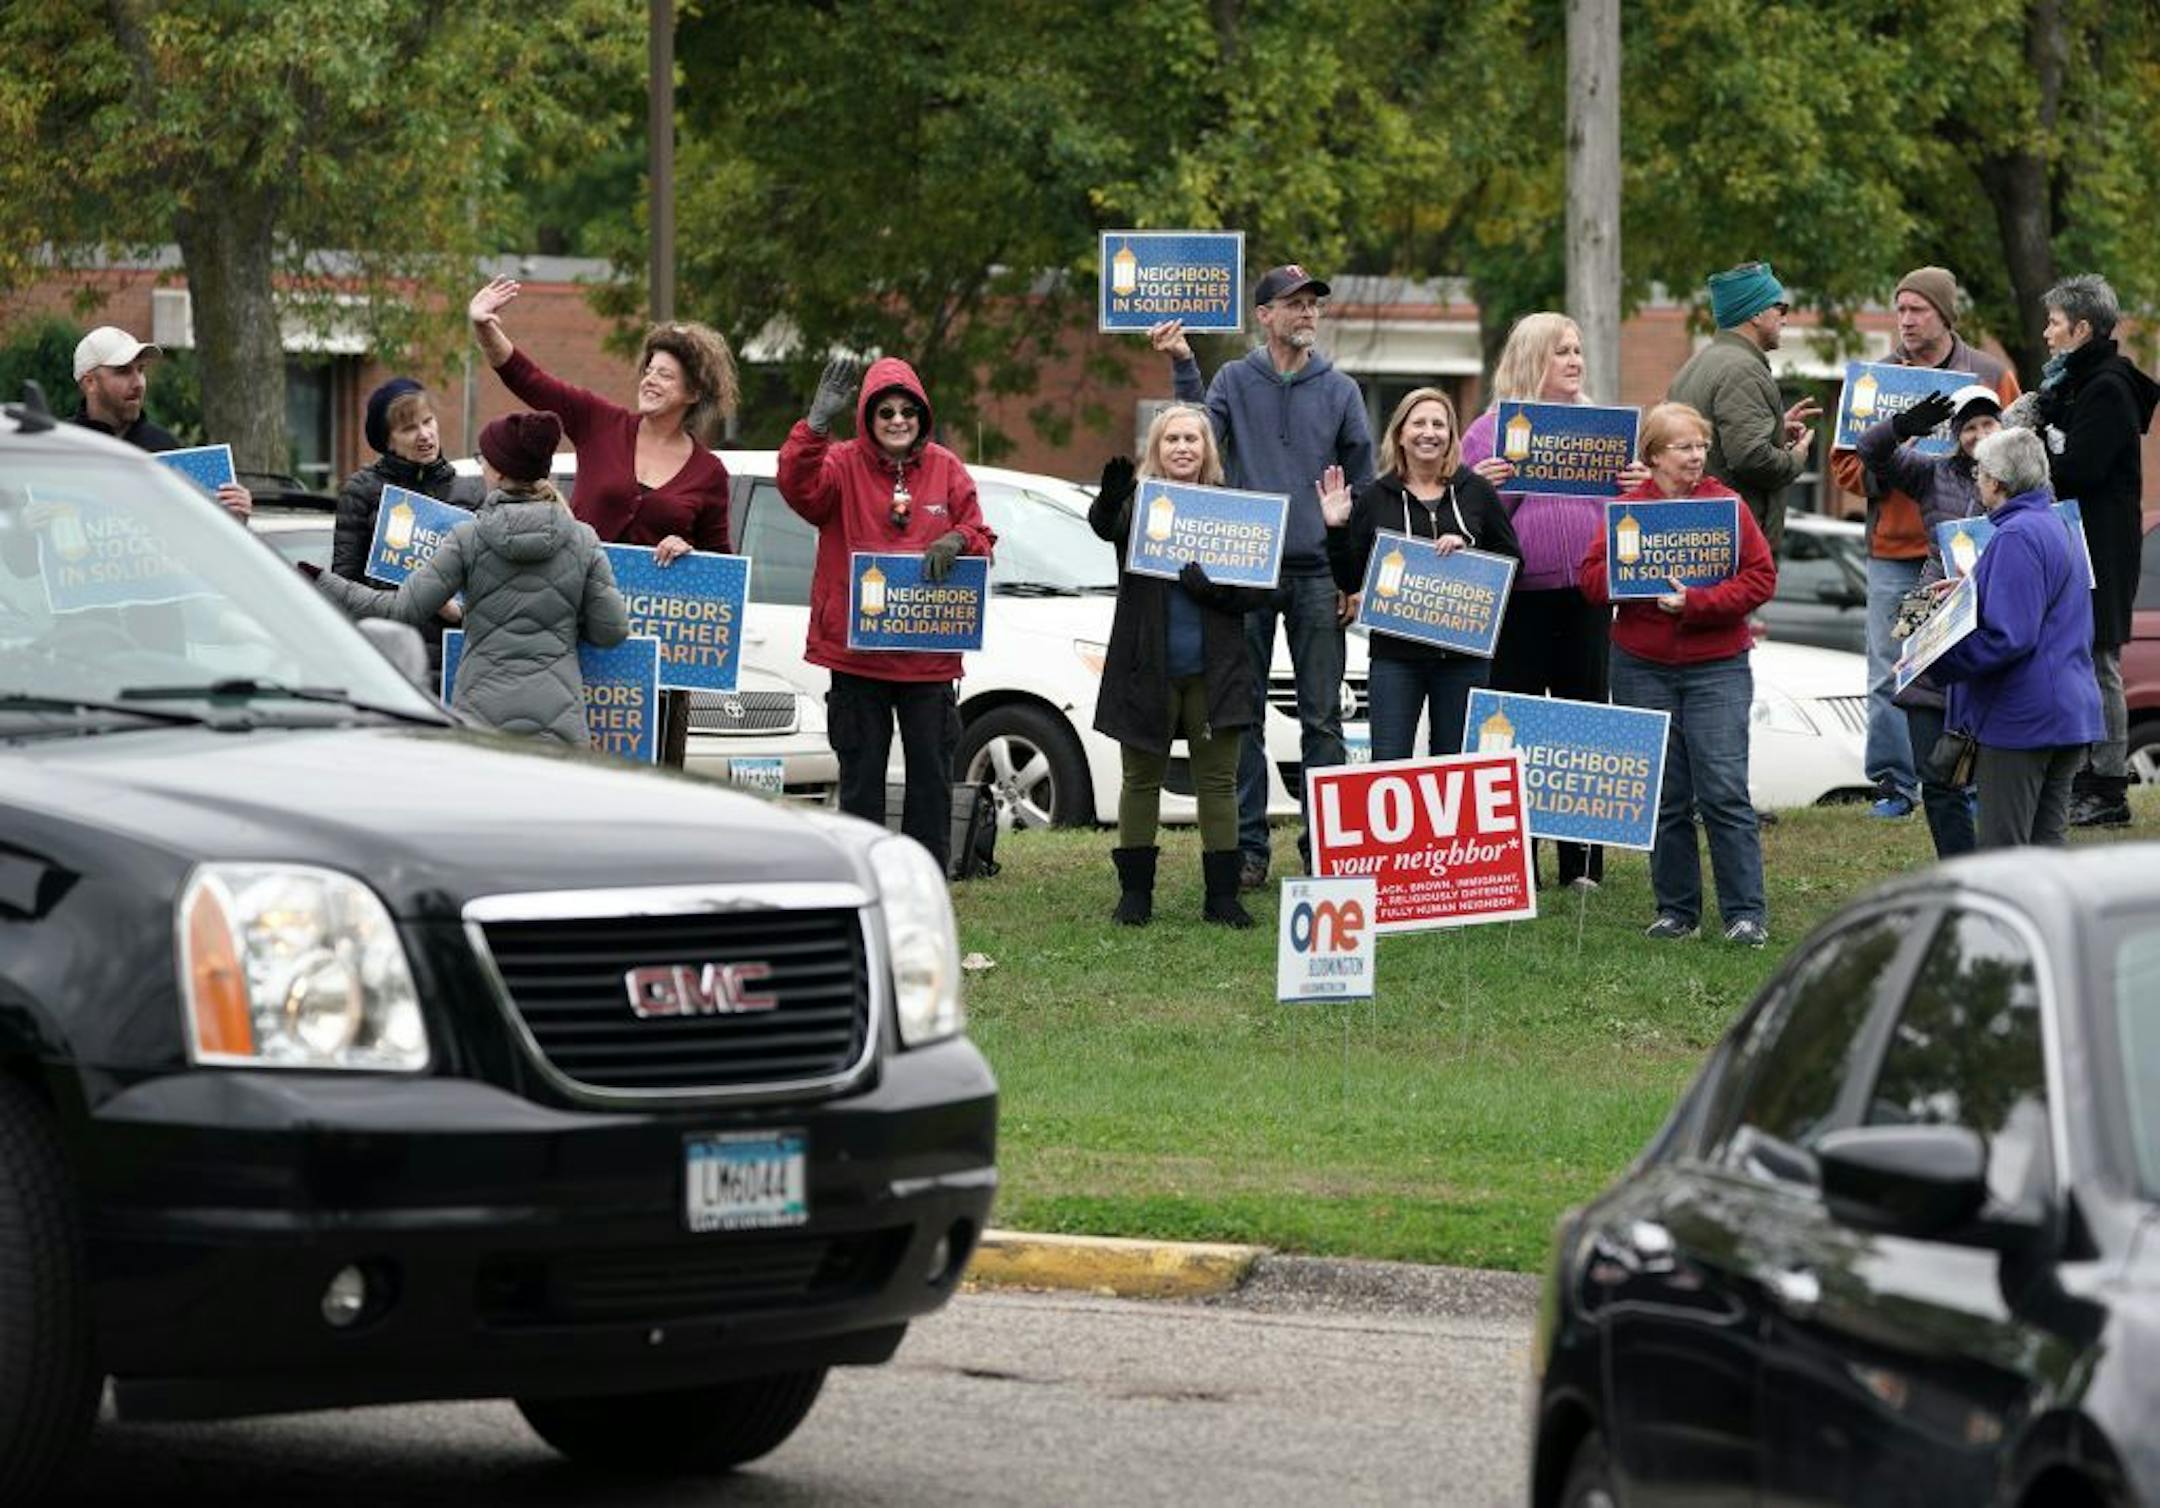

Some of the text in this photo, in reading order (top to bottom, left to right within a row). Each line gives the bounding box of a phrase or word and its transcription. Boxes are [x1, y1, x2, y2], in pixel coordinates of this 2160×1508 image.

[1137, 267, 1230, 282] NEIGHBORS
[1138, 282, 1230, 297] TOGETHER
[1113, 298, 1230, 313] IN SOLIDARITY
[1849, 419, 1865, 432] IN
[1532, 435, 1627, 453] NEIGHBORS
[1532, 450, 1626, 468] TOGETHER
[1526, 465, 1619, 482] SOLIDARIT
[1174, 517, 1273, 541] NEIGHBORS
[1642, 531, 1730, 548] NEIGHBORS
[1175, 532, 1269, 555] TOGETHER
[381, 548, 399, 565] IN
[1144, 541, 1269, 569] IN SOLIDARITY
[1643, 548, 1730, 564] TOGETHER
[1619, 563, 1730, 580] IN SOLIDARITY
[887, 587, 978, 604] NEIGHBORS
[1402, 573, 1496, 603] NEIGHBORS
[625, 595, 732, 623] IGHBORS
[888, 603, 976, 619] TOGETHER
[1402, 588, 1492, 620] TOGETHER
[860, 618, 976, 635] IN SOLIDARITY
[1372, 598, 1489, 635] IN SOLIDARITY
[629, 620, 729, 645] GETHER
[660, 642, 729, 667] ARITY
[1516, 743, 1649, 778] NEIGHBORS
[1526, 768, 1647, 800] OGETHER
[1321, 767, 1517, 848] LOVE
[1526, 790, 1644, 822] OLIDARITY
[1330, 854, 1387, 876] your
[1381, 906, 1413, 918] FULLY
[1417, 903, 1457, 915] HUMAN
[1290, 899, 1365, 954] one
[625, 962, 779, 1018] GMC
